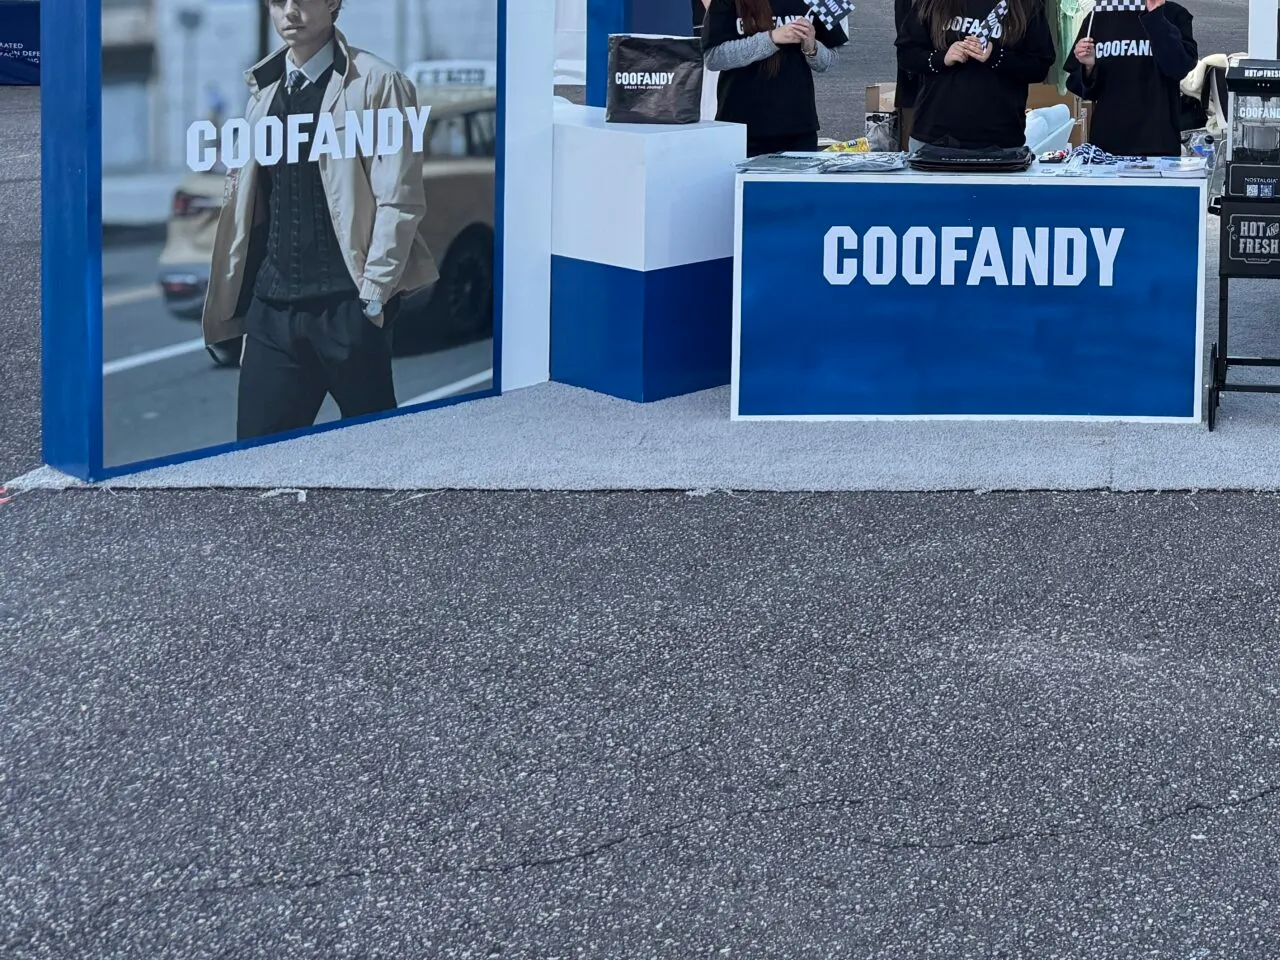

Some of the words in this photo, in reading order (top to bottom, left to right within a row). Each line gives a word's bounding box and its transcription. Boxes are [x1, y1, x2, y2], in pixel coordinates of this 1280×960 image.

[1096, 40, 1153, 59] COOFAN
[615, 72, 675, 85] COOFANDY
[186, 105, 431, 172] COOFANDY
[1240, 221, 1265, 236] HOT
[1239, 238, 1279, 254] FRESH
[823, 226, 1124, 286] COOFANDY
